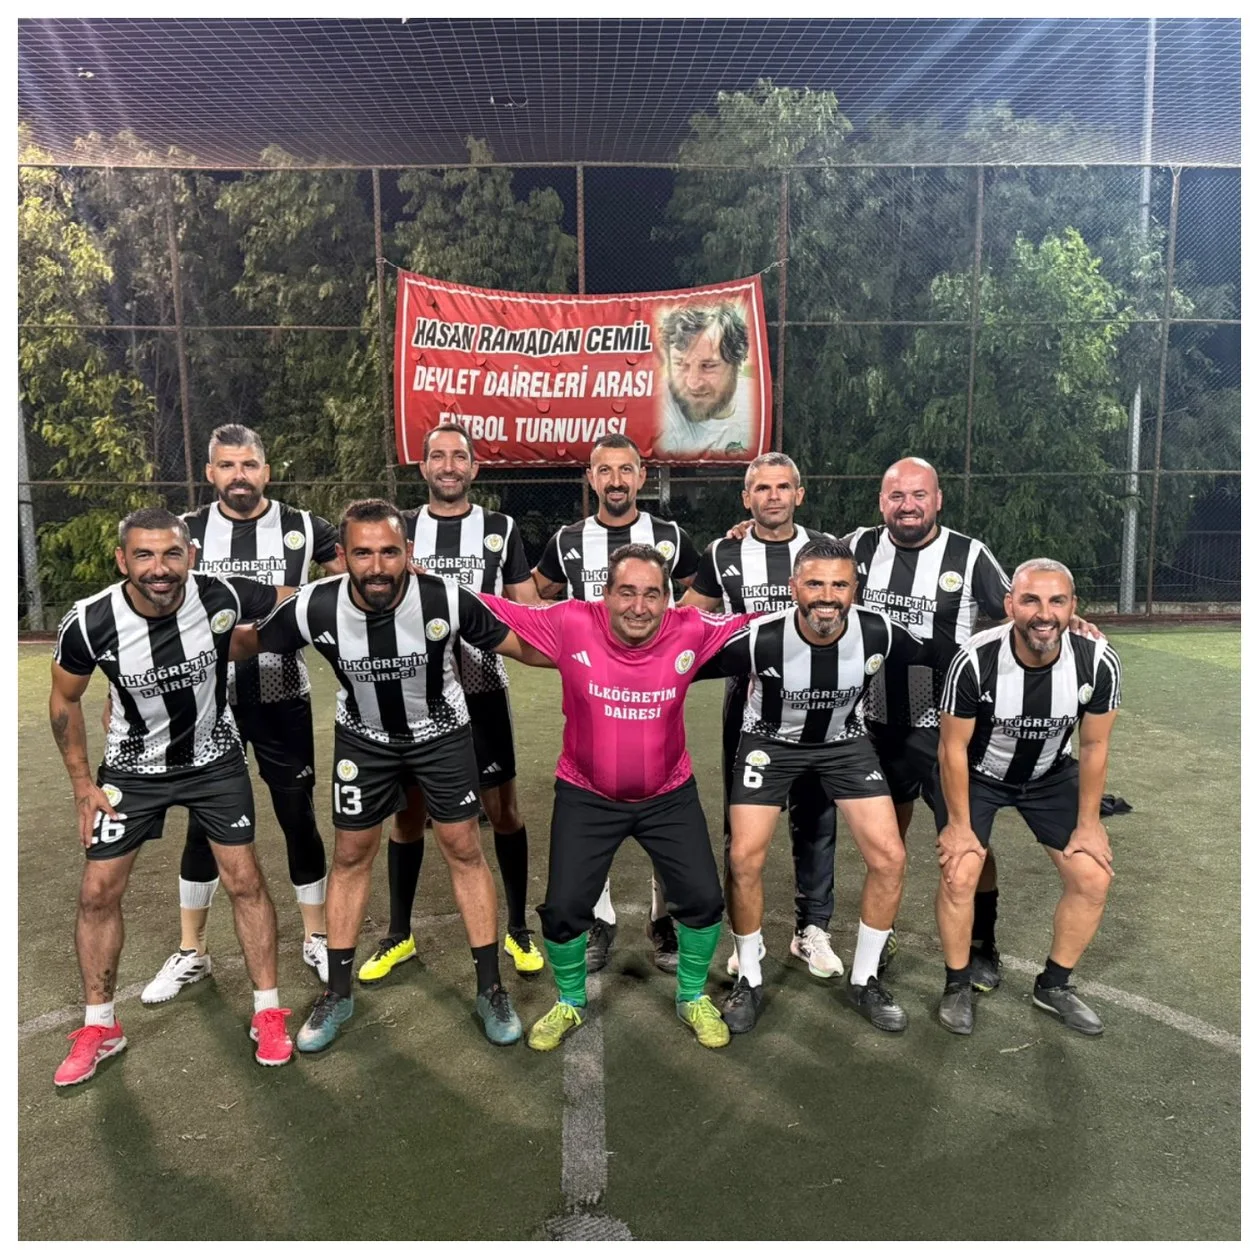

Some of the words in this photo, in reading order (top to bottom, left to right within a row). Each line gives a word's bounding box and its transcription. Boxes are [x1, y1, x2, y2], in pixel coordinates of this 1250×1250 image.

[413, 317, 474, 351] HASAN
[476, 326, 582, 356] RAMADAN
[585, 320, 652, 353] CEMİL
[413, 366, 480, 395] DEVLET
[482, 365, 588, 397] DAİRELERİ
[591, 370, 653, 397] ARASI
[515, 417, 627, 442] TURNUVASI
[118, 649, 219, 688] İLKÖĞRETİM
[338, 652, 429, 671] İLKÖĞRETİM
[141, 669, 207, 698] DAİRESİ
[588, 680, 676, 703] İLKÖĞRETİM
[604, 703, 661, 720] DAİRESİ
[743, 765, 766, 789] 6
[335, 782, 362, 815] 13
